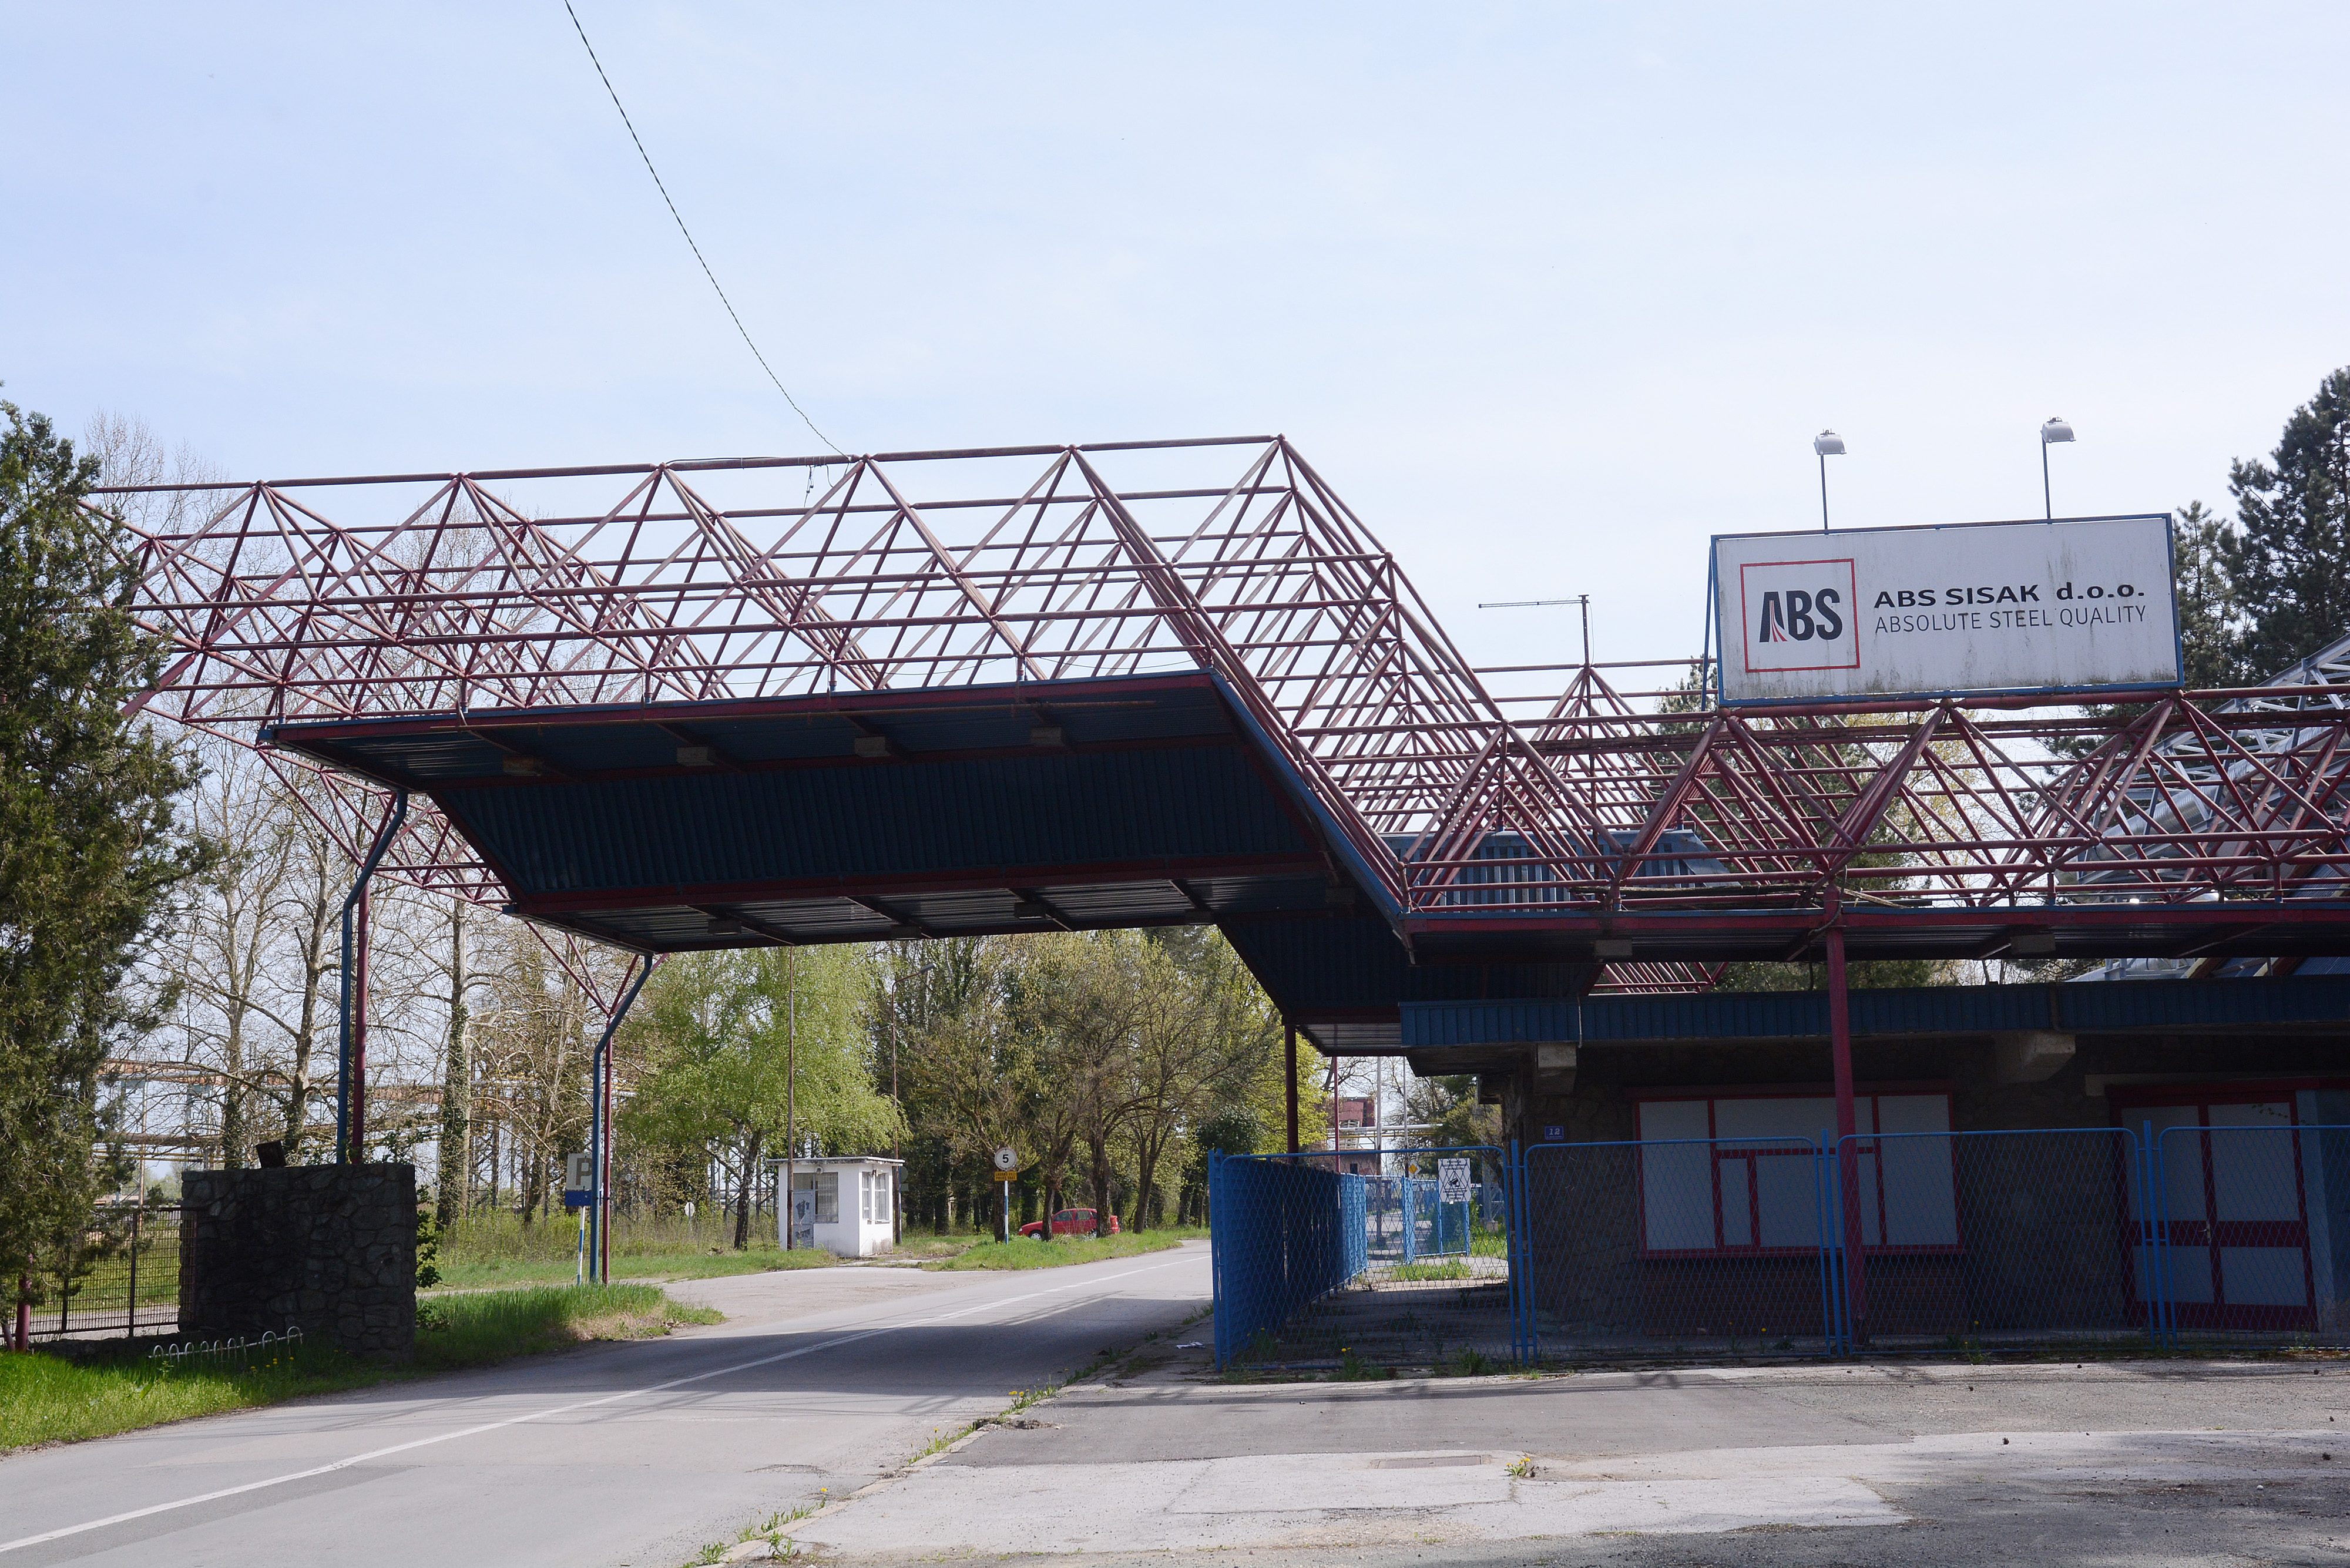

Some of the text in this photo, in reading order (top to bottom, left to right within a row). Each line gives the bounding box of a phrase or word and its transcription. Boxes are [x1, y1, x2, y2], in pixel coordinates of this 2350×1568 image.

[1874, 582, 2144, 609] ABS SISAK d.o.o.
[1760, 588, 1843, 643] ABS
[1875, 605, 2146, 633] ABSOLUTE STEEL QUALITY
[576, 1158, 592, 1186] P
[1002, 1154, 1009, 1163] 5
